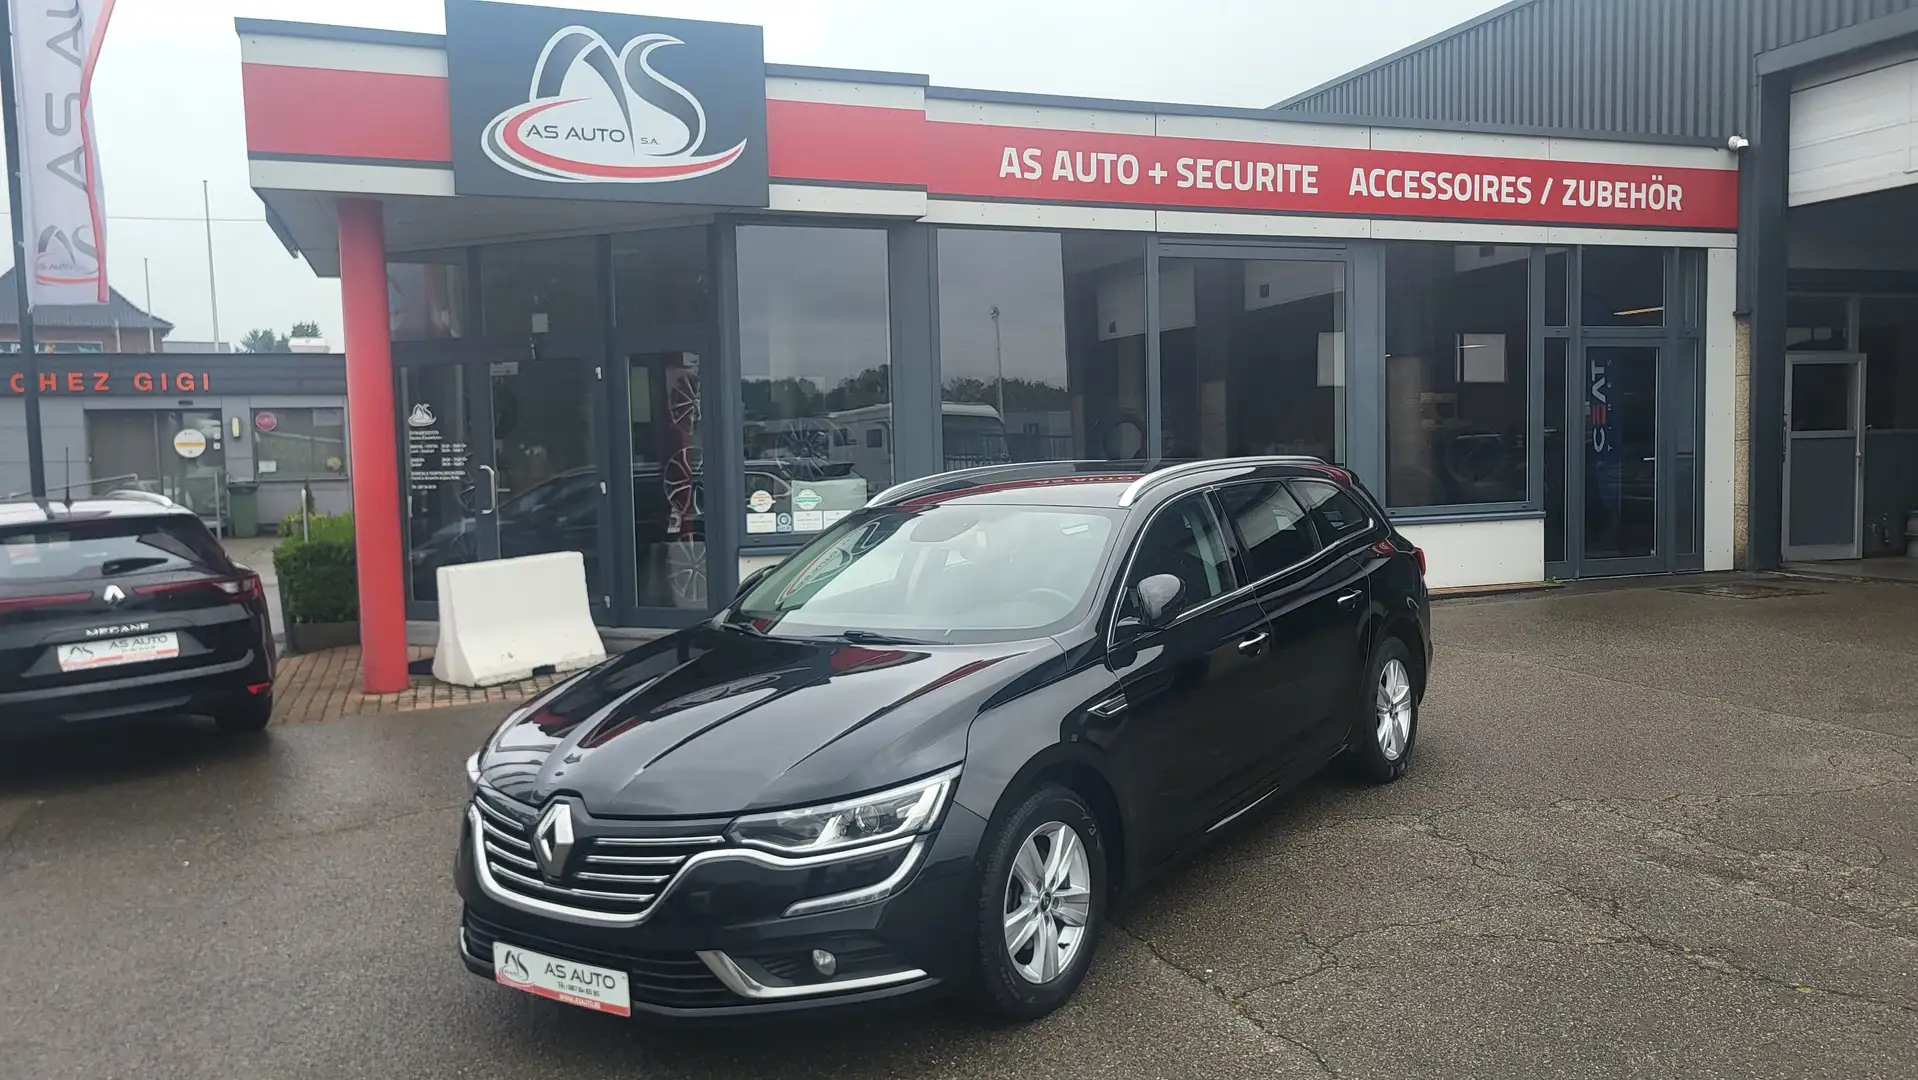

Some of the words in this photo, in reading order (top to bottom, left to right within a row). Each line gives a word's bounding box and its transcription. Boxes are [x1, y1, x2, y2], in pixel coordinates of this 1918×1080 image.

[526, 124, 559, 140] AS
[565, 127, 625, 143] AUTO
[999, 147, 1042, 180] AS
[1052, 150, 1139, 185] AUTO
[1149, 162, 1168, 185] +
[1176, 157, 1318, 194] SECURITE
[1349, 167, 1532, 205] ACCESSOIRES
[1540, 177, 1553, 205] /
[1562, 175, 1683, 211] ZUBEHÖR
[9, 372, 110, 393] CHEZ
[133, 372, 210, 391] GIGI
[1590, 359, 1606, 452] CEAT
[86, 623, 150, 637] MEGANE
[133, 635, 168, 646] AUTO
[544, 961, 567, 979] AS
[570, 968, 616, 990] AUTO
